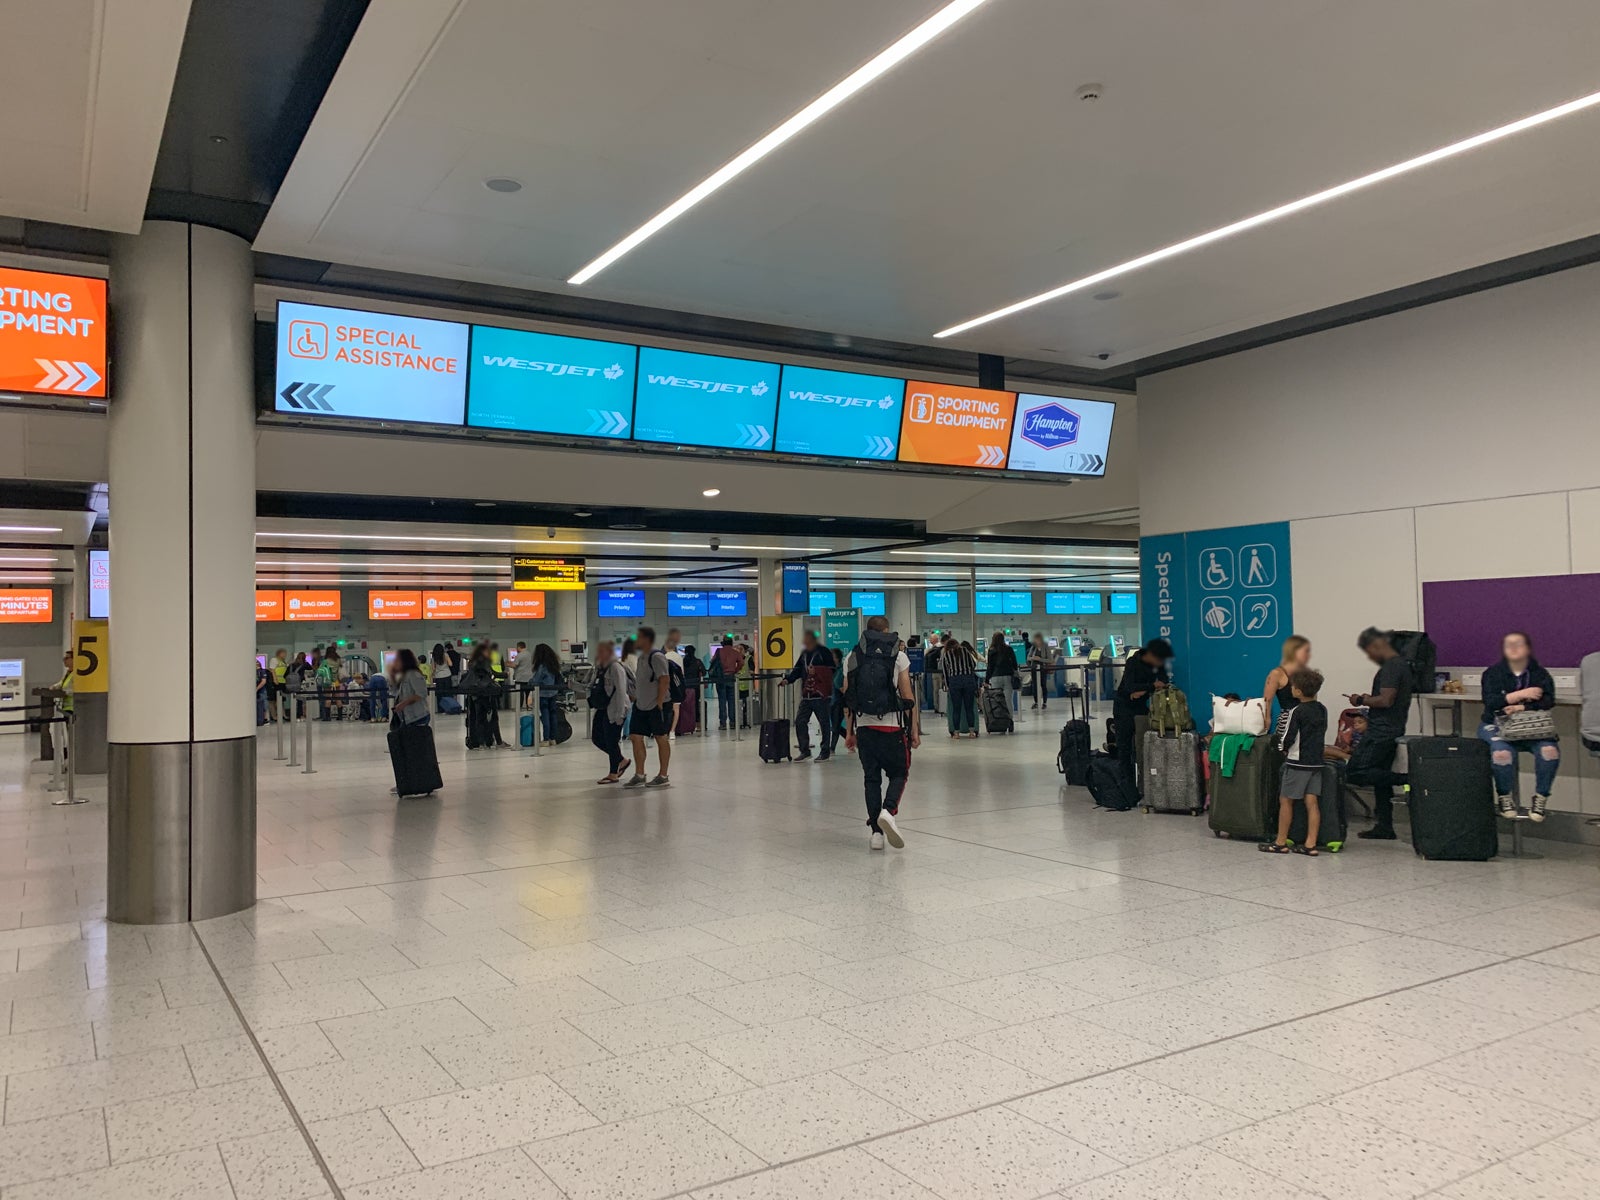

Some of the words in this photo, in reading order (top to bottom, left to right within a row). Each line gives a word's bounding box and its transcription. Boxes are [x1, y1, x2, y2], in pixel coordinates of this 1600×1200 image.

[335, 325, 422, 350] SPECIAL
[334, 346, 458, 374] ASSISTANCE
[483, 355, 603, 377] WESTJET
[647, 373, 749, 393] WESTJET
[788, 390, 876, 407] WESTJET
[937, 396, 1000, 415] SPORTING
[935, 411, 1008, 431] EQUIPMENT
[1025, 413, 1078, 433] Hampton
[1155, 551, 1174, 621] Special
[1, 602, 49, 610] MINUTES
[766, 627, 786, 657] 6
[76, 636, 99, 676] 5
